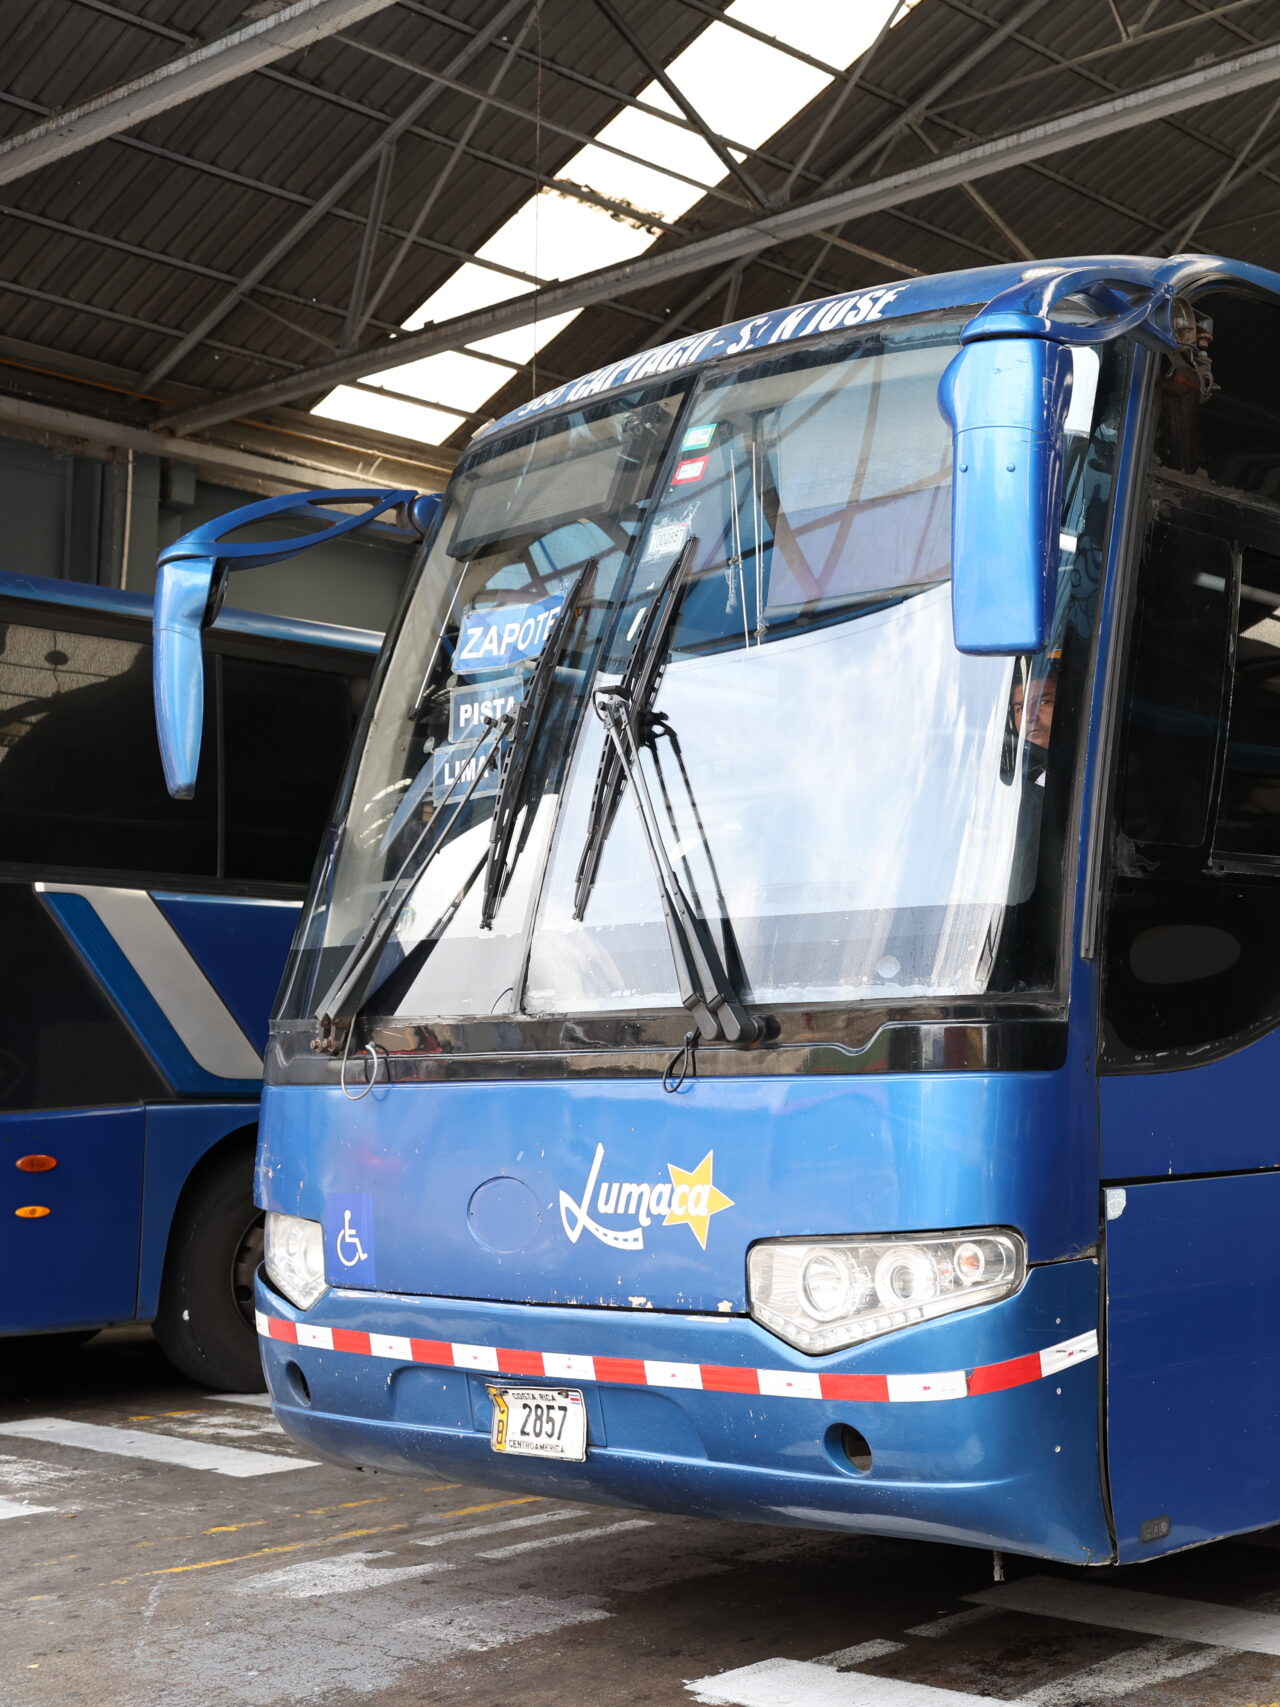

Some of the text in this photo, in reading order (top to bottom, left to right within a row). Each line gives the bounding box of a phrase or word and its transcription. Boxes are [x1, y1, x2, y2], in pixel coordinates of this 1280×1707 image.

[559, 1142, 711, 1250] Lumaca
[511, 1392, 557, 1402] COSTA RICA
[520, 1403, 568, 1441] 2857
[508, 1439, 566, 1453] CENTROAMERICA
